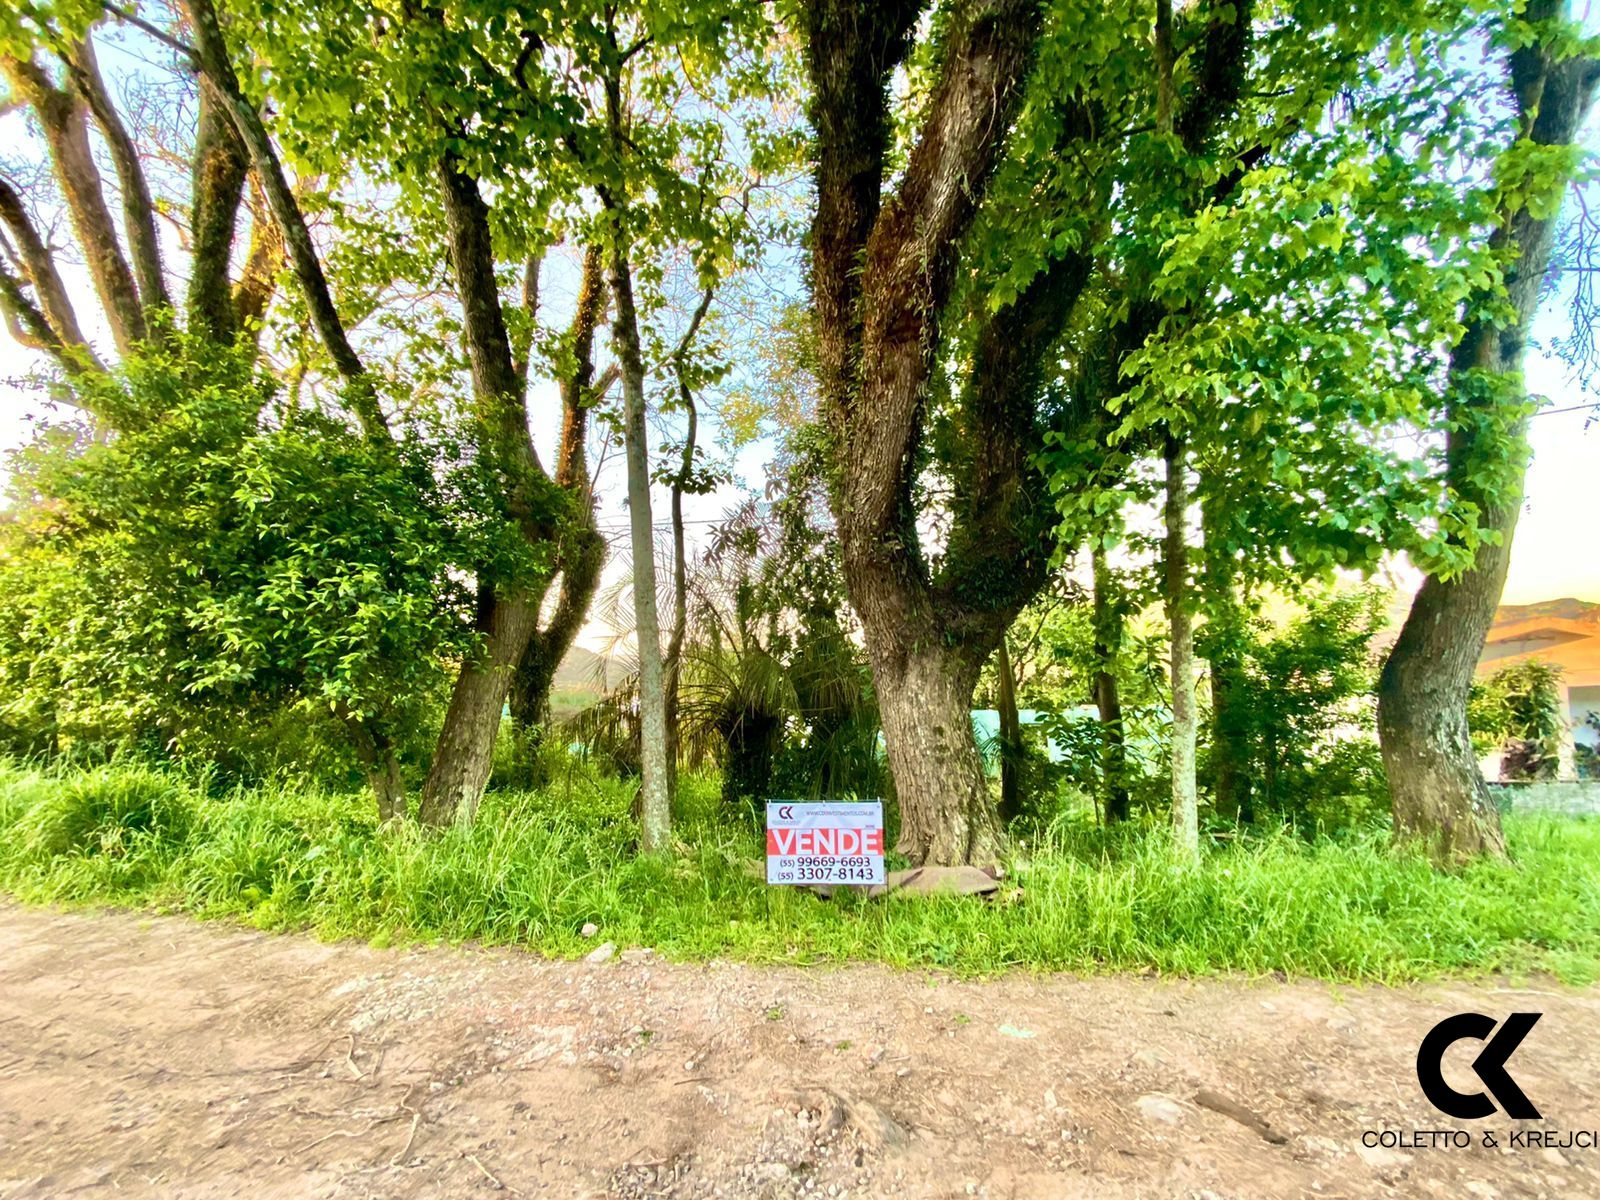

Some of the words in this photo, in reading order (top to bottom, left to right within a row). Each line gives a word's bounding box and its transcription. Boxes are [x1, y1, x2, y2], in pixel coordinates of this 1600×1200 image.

[779, 806, 793, 820] CK
[772, 829, 878, 855] VENDE
[780, 859, 795, 868] (55)
[797, 857, 870, 867] 99669-6693
[778, 872, 794, 881] (55)
[797, 868, 874, 880] 3307-8143
